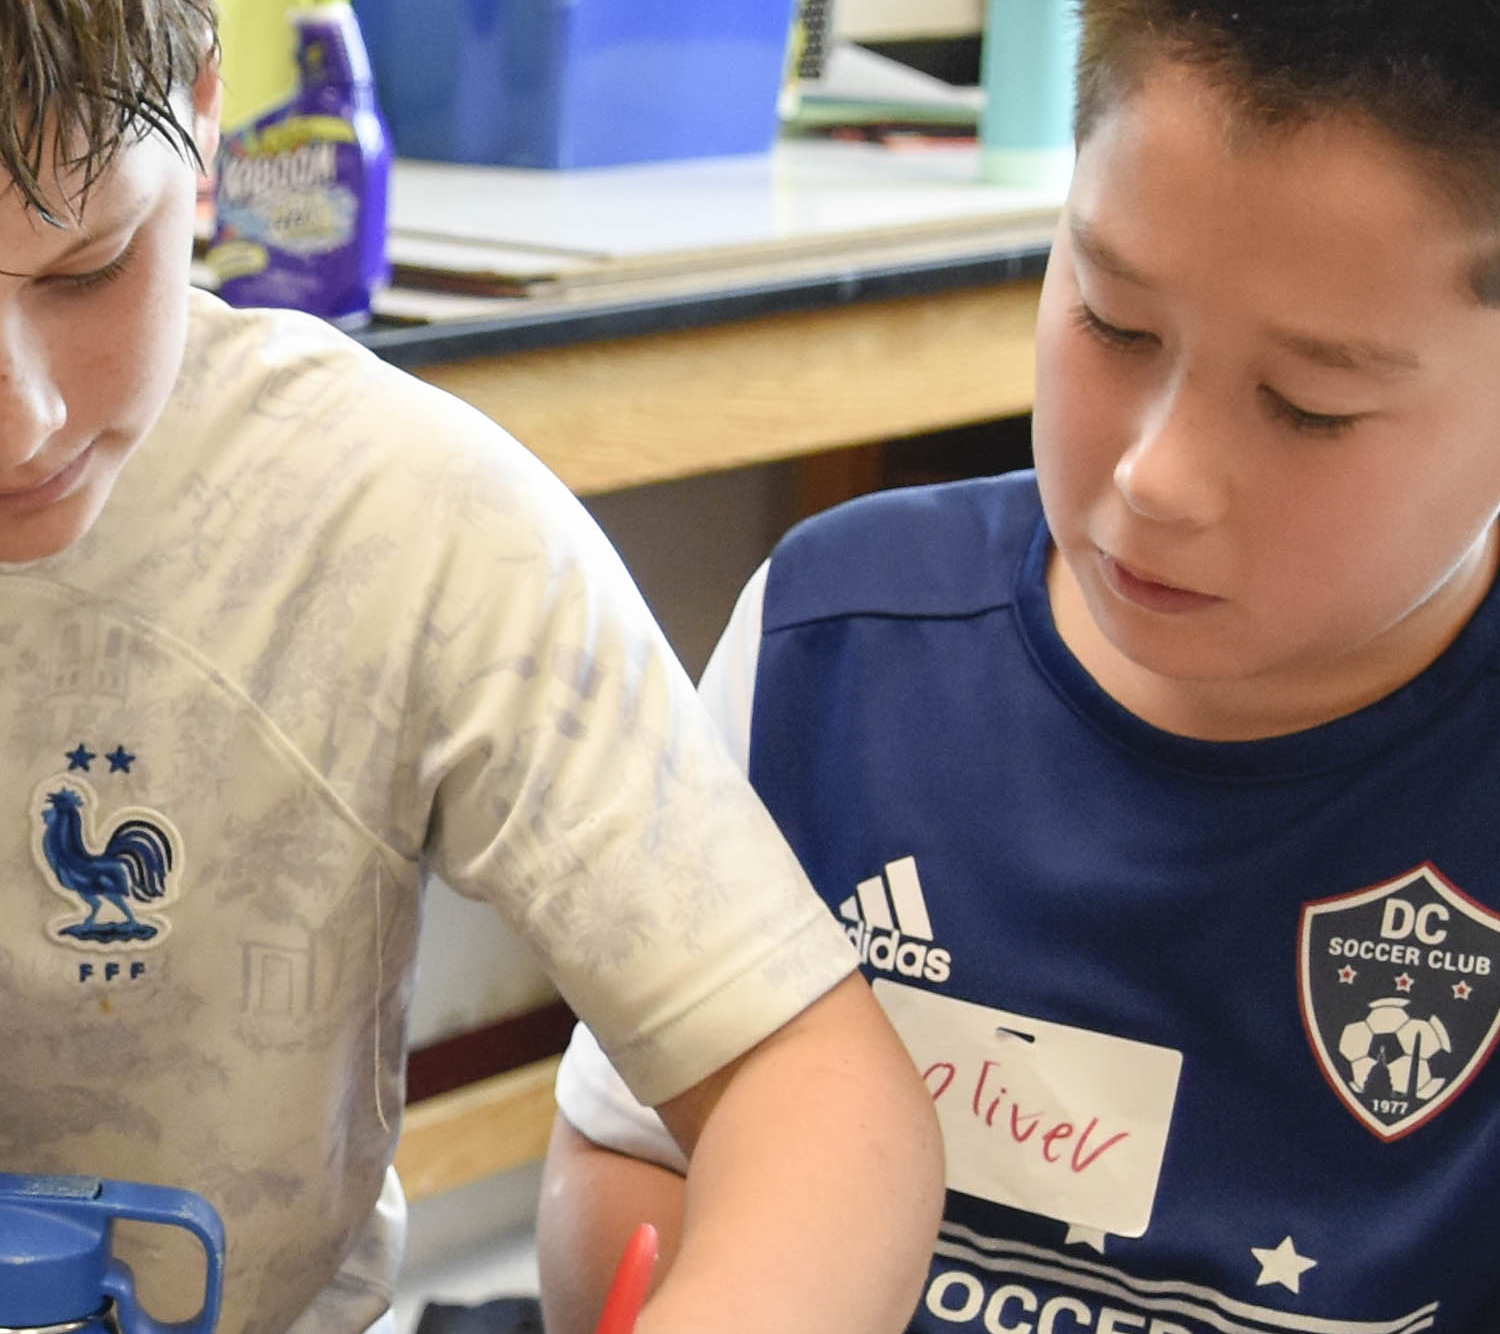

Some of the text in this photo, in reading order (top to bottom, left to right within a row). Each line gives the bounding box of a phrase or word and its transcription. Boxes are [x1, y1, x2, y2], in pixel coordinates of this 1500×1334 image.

[1380, 898, 1449, 945] DC
[844, 920, 952, 983] didas
[1328, 937, 1492, 976] SOCCER CLUB
[1371, 1099, 1409, 1116] 1977
